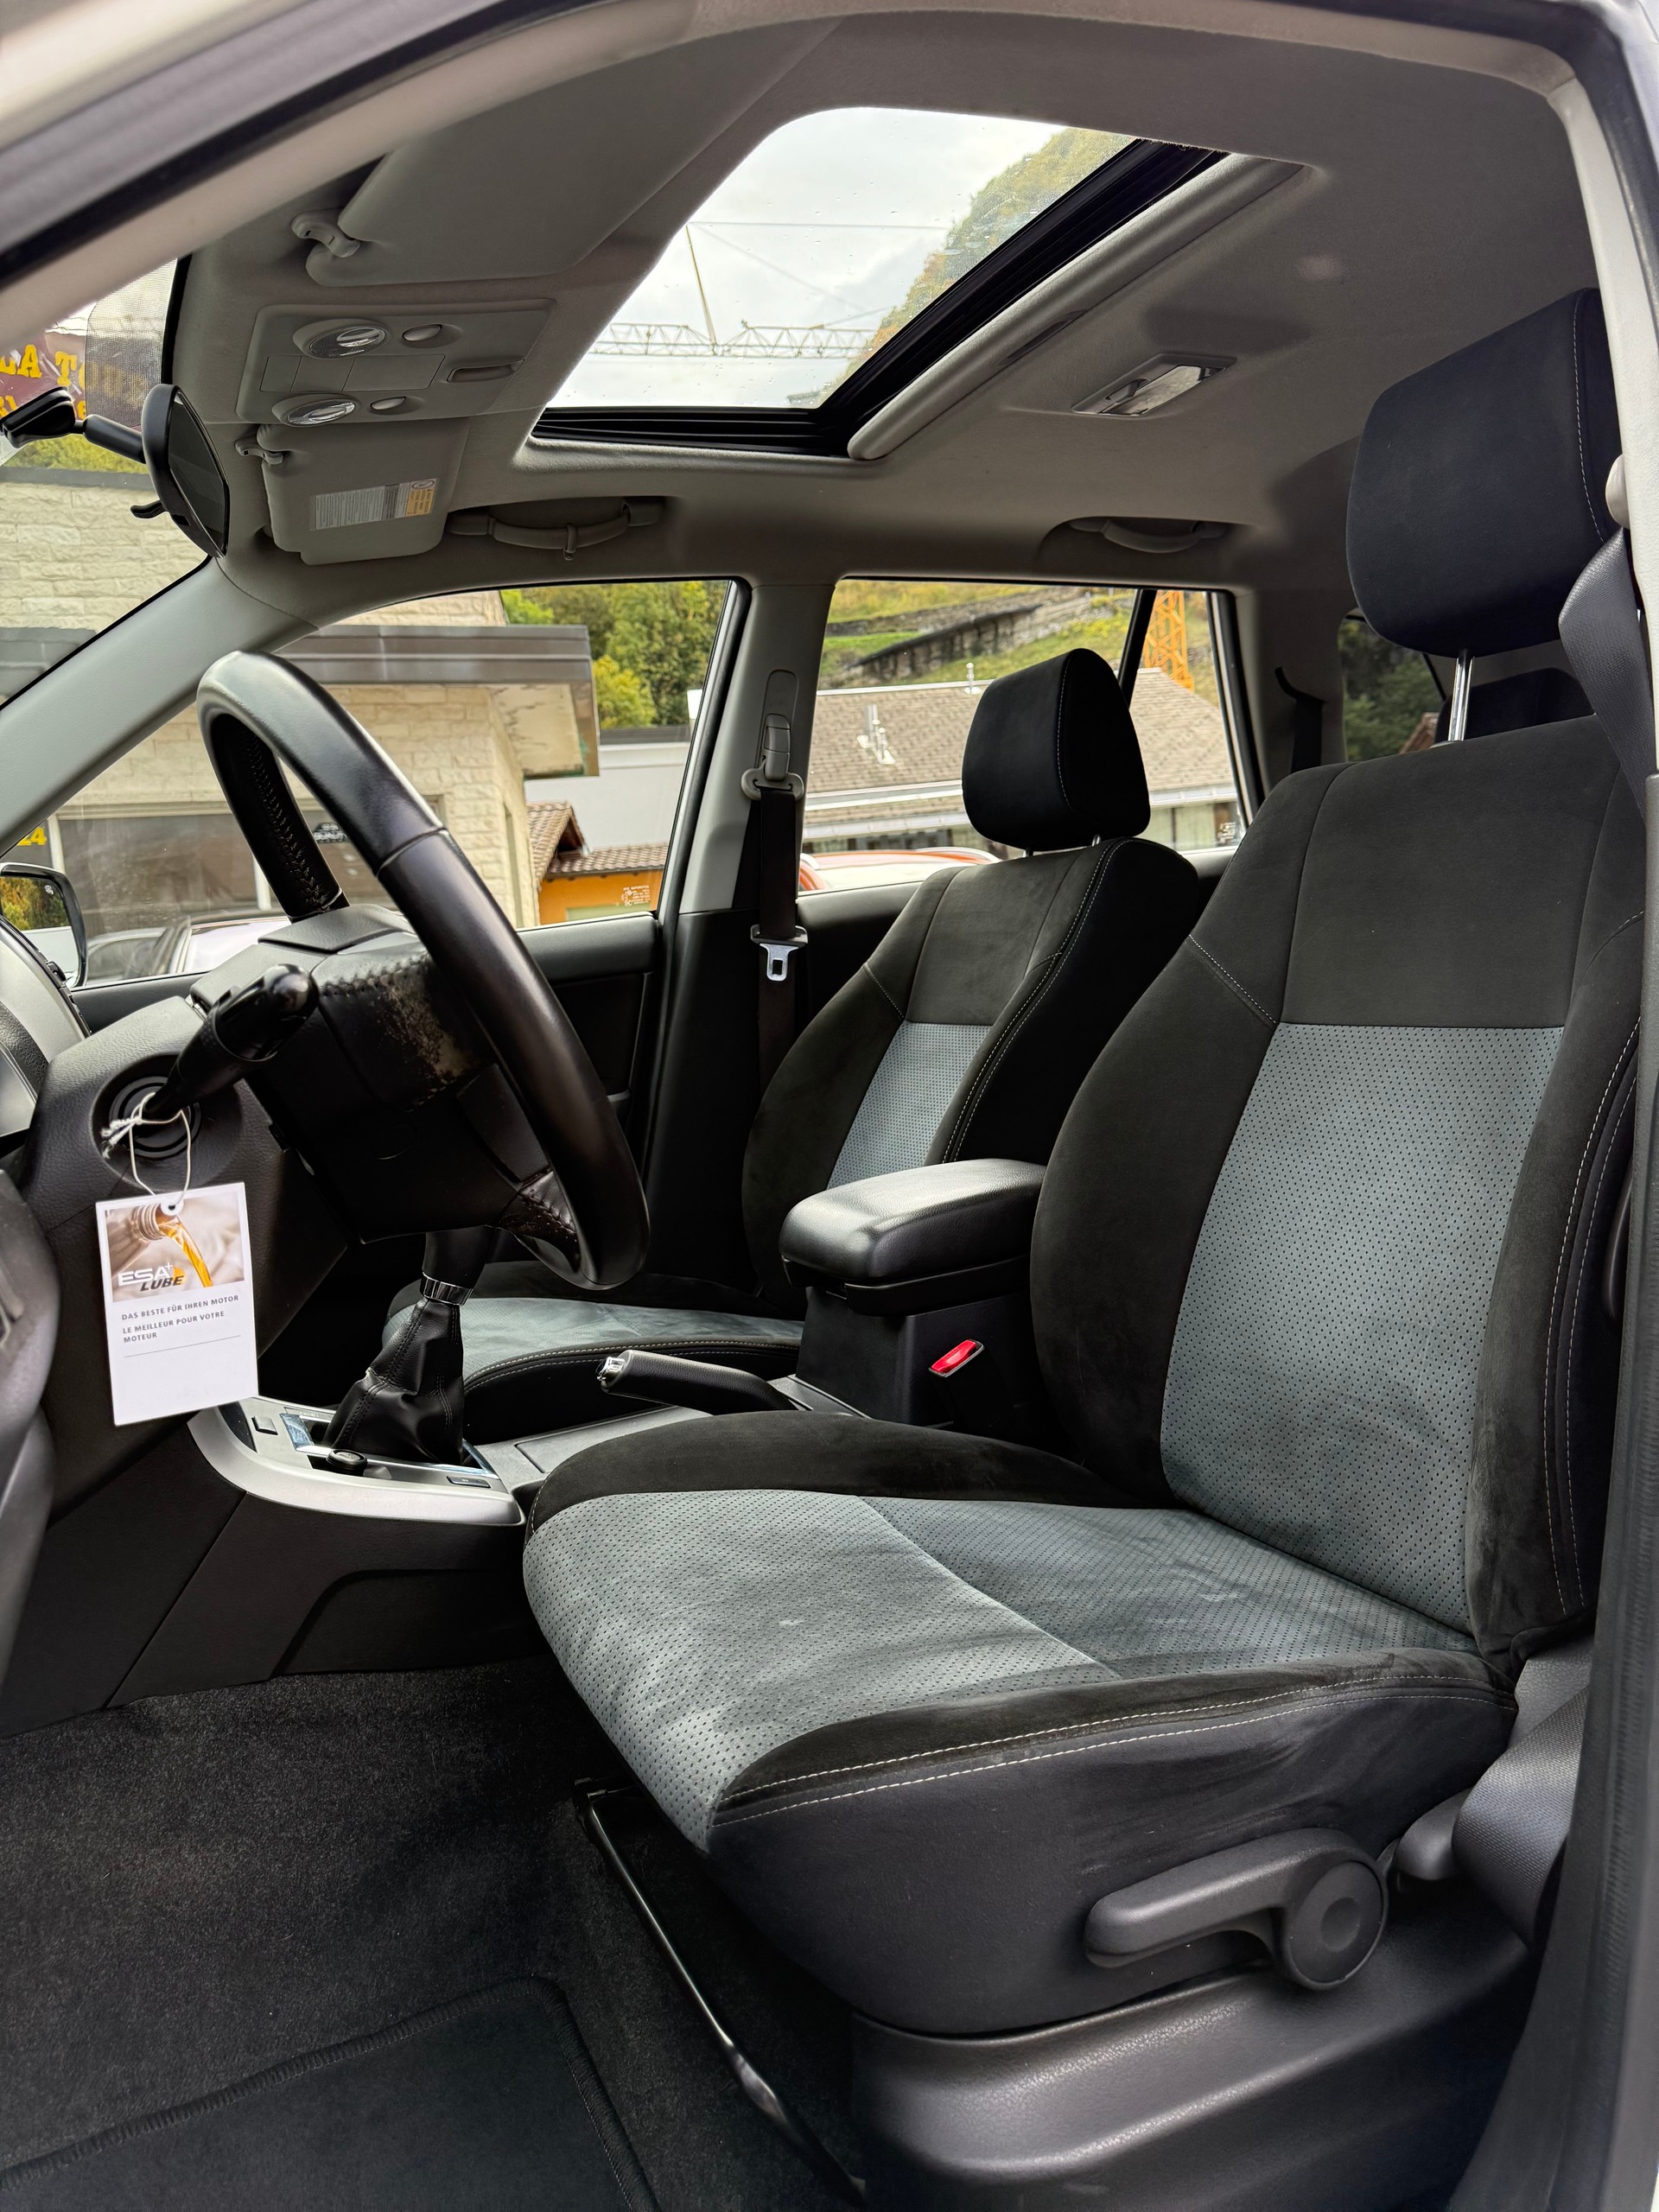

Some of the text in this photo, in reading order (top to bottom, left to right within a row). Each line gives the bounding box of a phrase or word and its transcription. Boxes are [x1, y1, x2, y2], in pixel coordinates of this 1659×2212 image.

[140, 1275, 184, 1292] LUBE
[141, 1308, 165, 1318] BESTE
[185, 1300, 208, 1310] IHREN
[211, 1295, 238, 1306] MOTOR
[134, 1320, 174, 1332] MEILLEUR
[176, 1316, 198, 1325] POUR
[200, 1311, 225, 1320] VOTRE
[124, 1332, 157, 1343] MOTEUR
